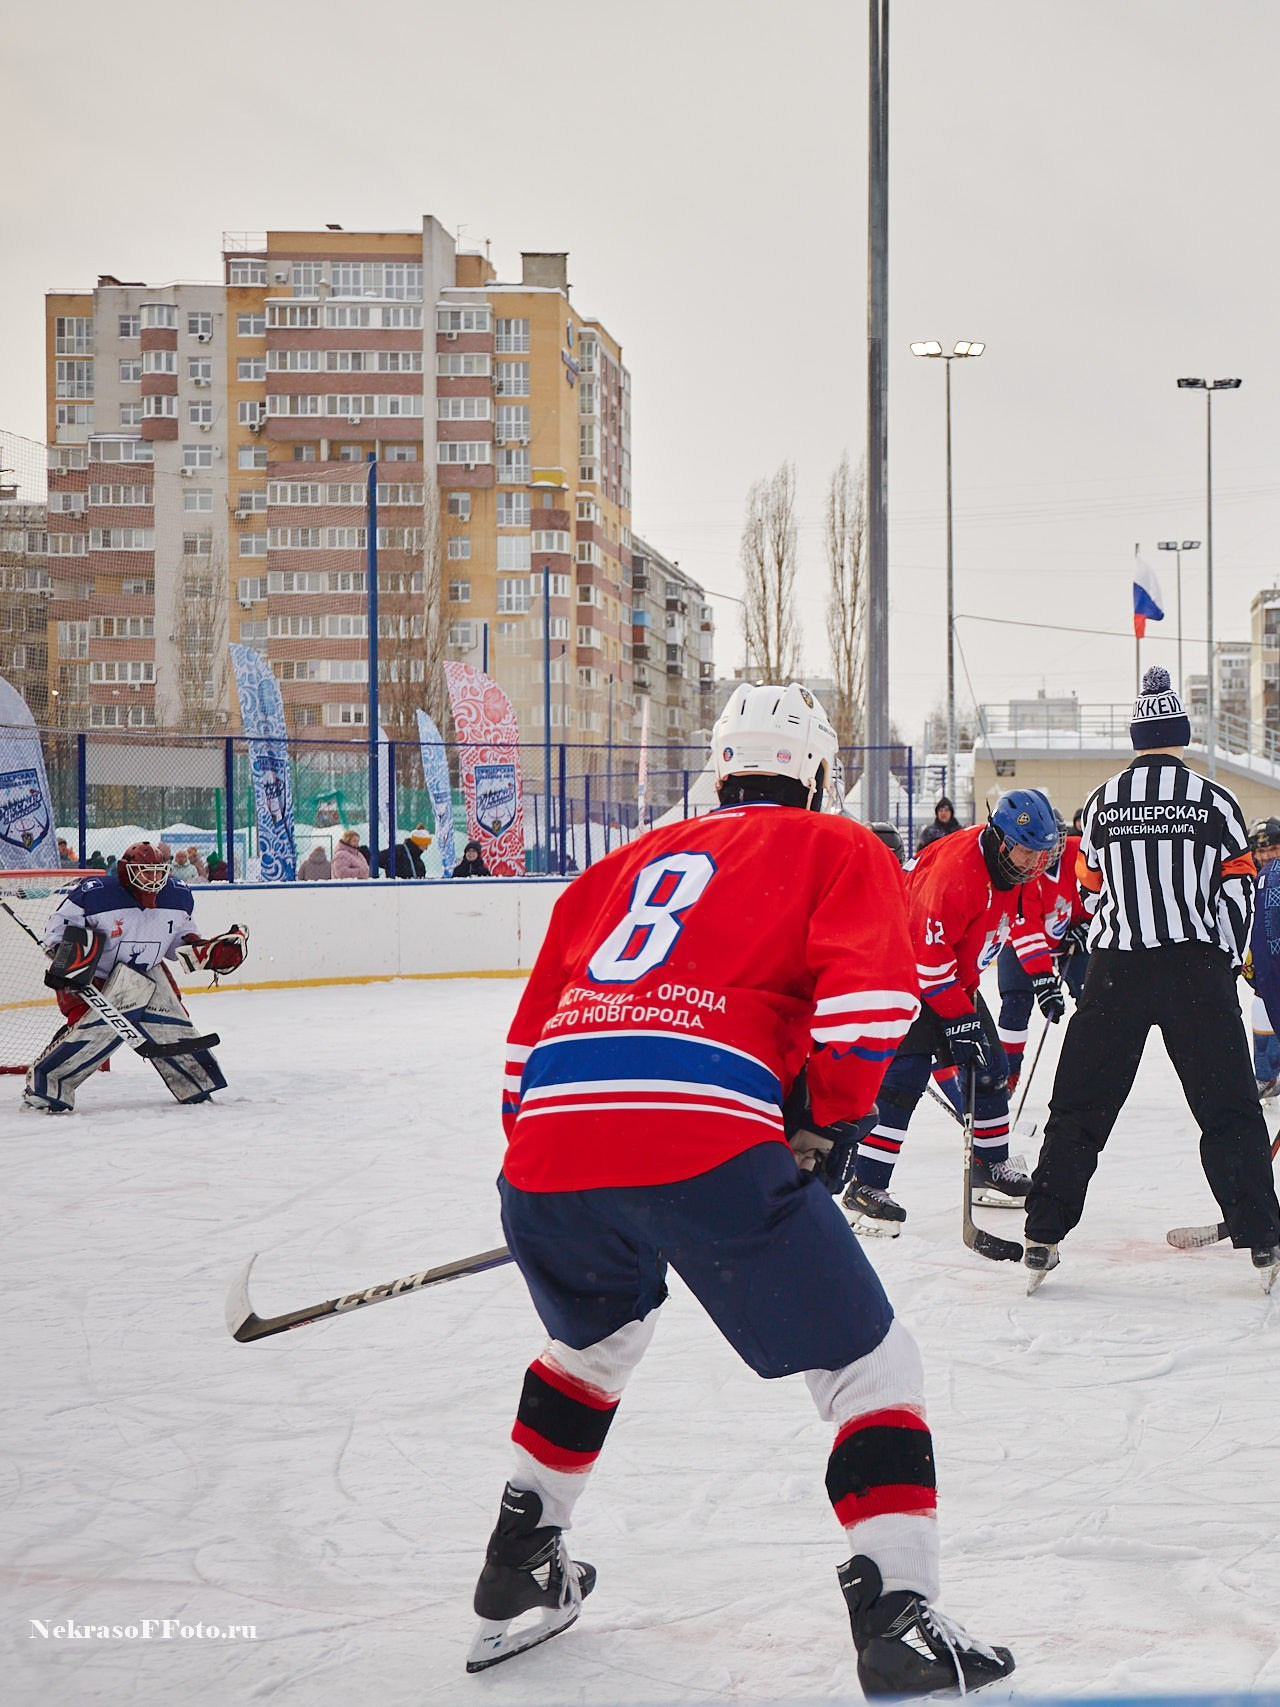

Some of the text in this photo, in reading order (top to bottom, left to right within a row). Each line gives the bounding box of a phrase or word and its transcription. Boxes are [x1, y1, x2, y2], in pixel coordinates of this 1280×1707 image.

[1097, 805, 1209, 836] ОФИЦЕРСКАЯ
[1108, 823, 1195, 837] ХОККЕЙНАЯ ЛИГА
[167, 920, 174, 934] 1
[587, 850, 718, 984] 8
[581, 1005, 704, 1029] НОВГОРОДА
[335, 1269, 428, 1312] CCM
